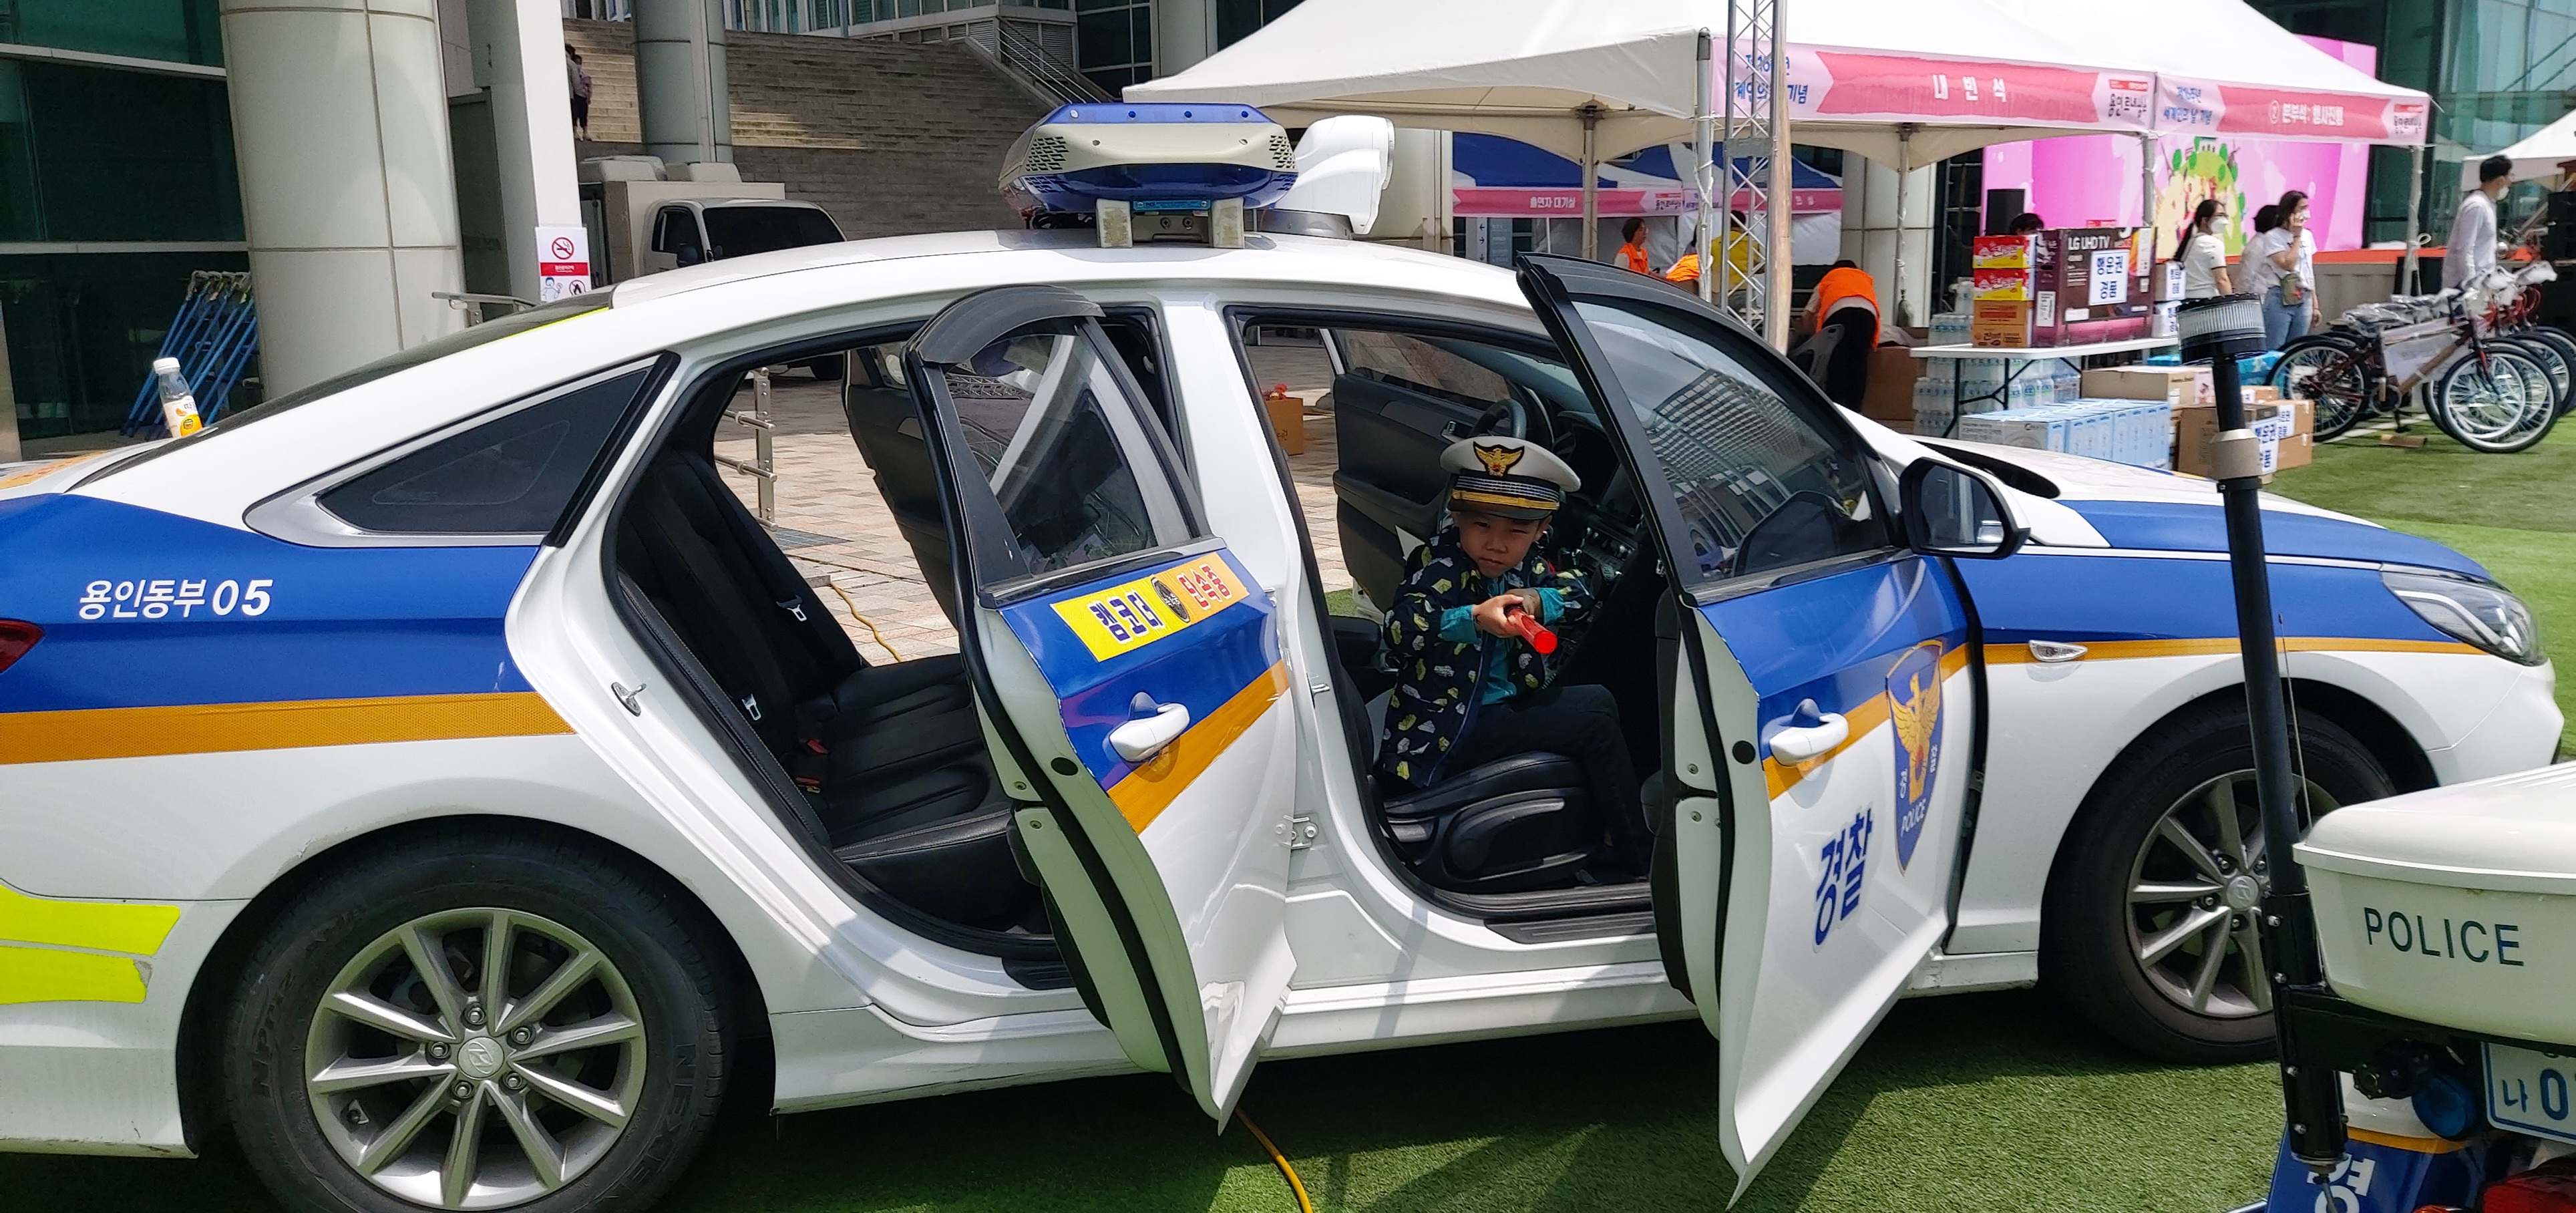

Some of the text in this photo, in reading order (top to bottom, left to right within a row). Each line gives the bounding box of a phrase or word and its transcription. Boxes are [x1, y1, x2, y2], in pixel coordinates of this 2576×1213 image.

[1788, 84, 1808, 104] 기념
[2068, 236, 2080, 250] LG
[2081, 236, 2098, 250] UHD
[2097, 256, 2123, 275] 행운권
[2100, 281, 2117, 299] 경품
[79, 579, 273, 620] 용인동부 05
[1177, 564, 1231, 608] 단속중
[1089, 590, 1164, 642] 캠코더
[1901, 798, 1926, 837] POLICE
[1815, 808, 1873, 945] 경찰
[2364, 906, 2524, 967] POLICE
[2502, 1078, 2528, 1113] 나
